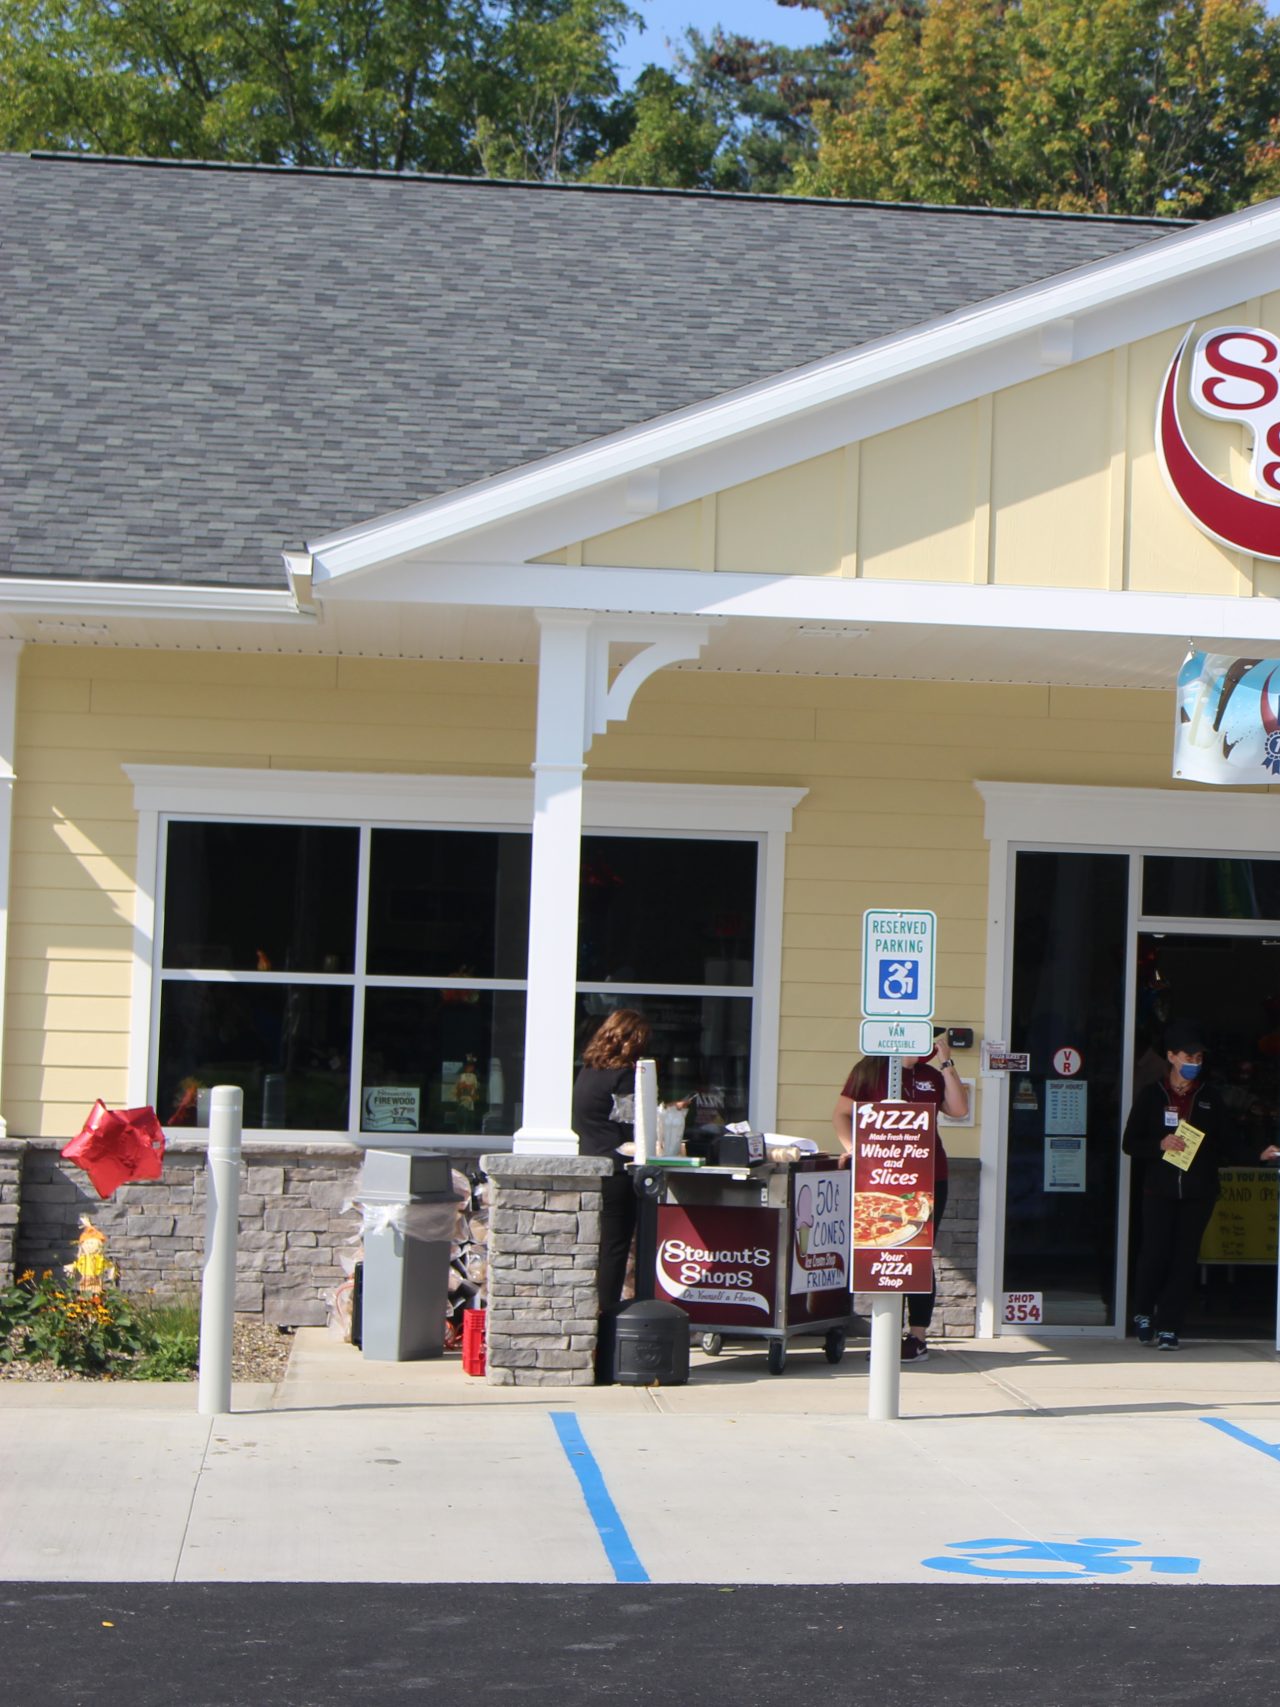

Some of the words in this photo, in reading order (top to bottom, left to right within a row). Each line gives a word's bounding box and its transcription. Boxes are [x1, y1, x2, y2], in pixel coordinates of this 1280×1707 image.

[872, 920, 927, 935] RESERVED
[875, 939, 923, 953] PARKING
[888, 1026, 905, 1037] VAN
[878, 1040, 916, 1049] ACCESSIBLE
[1063, 1051, 1072, 1061] V
[1063, 1062, 1072, 1073] R
[374, 1096, 416, 1105] FIREWOOD
[859, 1109, 930, 1131] PIZZA
[869, 1133, 887, 1141] Made
[887, 1133, 903, 1141] Fresh
[903, 1133, 921, 1142] Here!
[861, 1143, 902, 1158] Whole
[903, 1144, 930, 1159] Pies
[883, 1158, 905, 1169] and
[869, 1168, 919, 1185] Slices
[813, 1220, 845, 1247] CONES
[880, 1251, 903, 1262] Your
[680, 1263, 753, 1287] Shops
[871, 1262, 913, 1276] PIZZA
[878, 1276, 903, 1288] Shop
[1008, 1294, 1035, 1303] SHOP
[1005, 1304, 1040, 1322] 354
